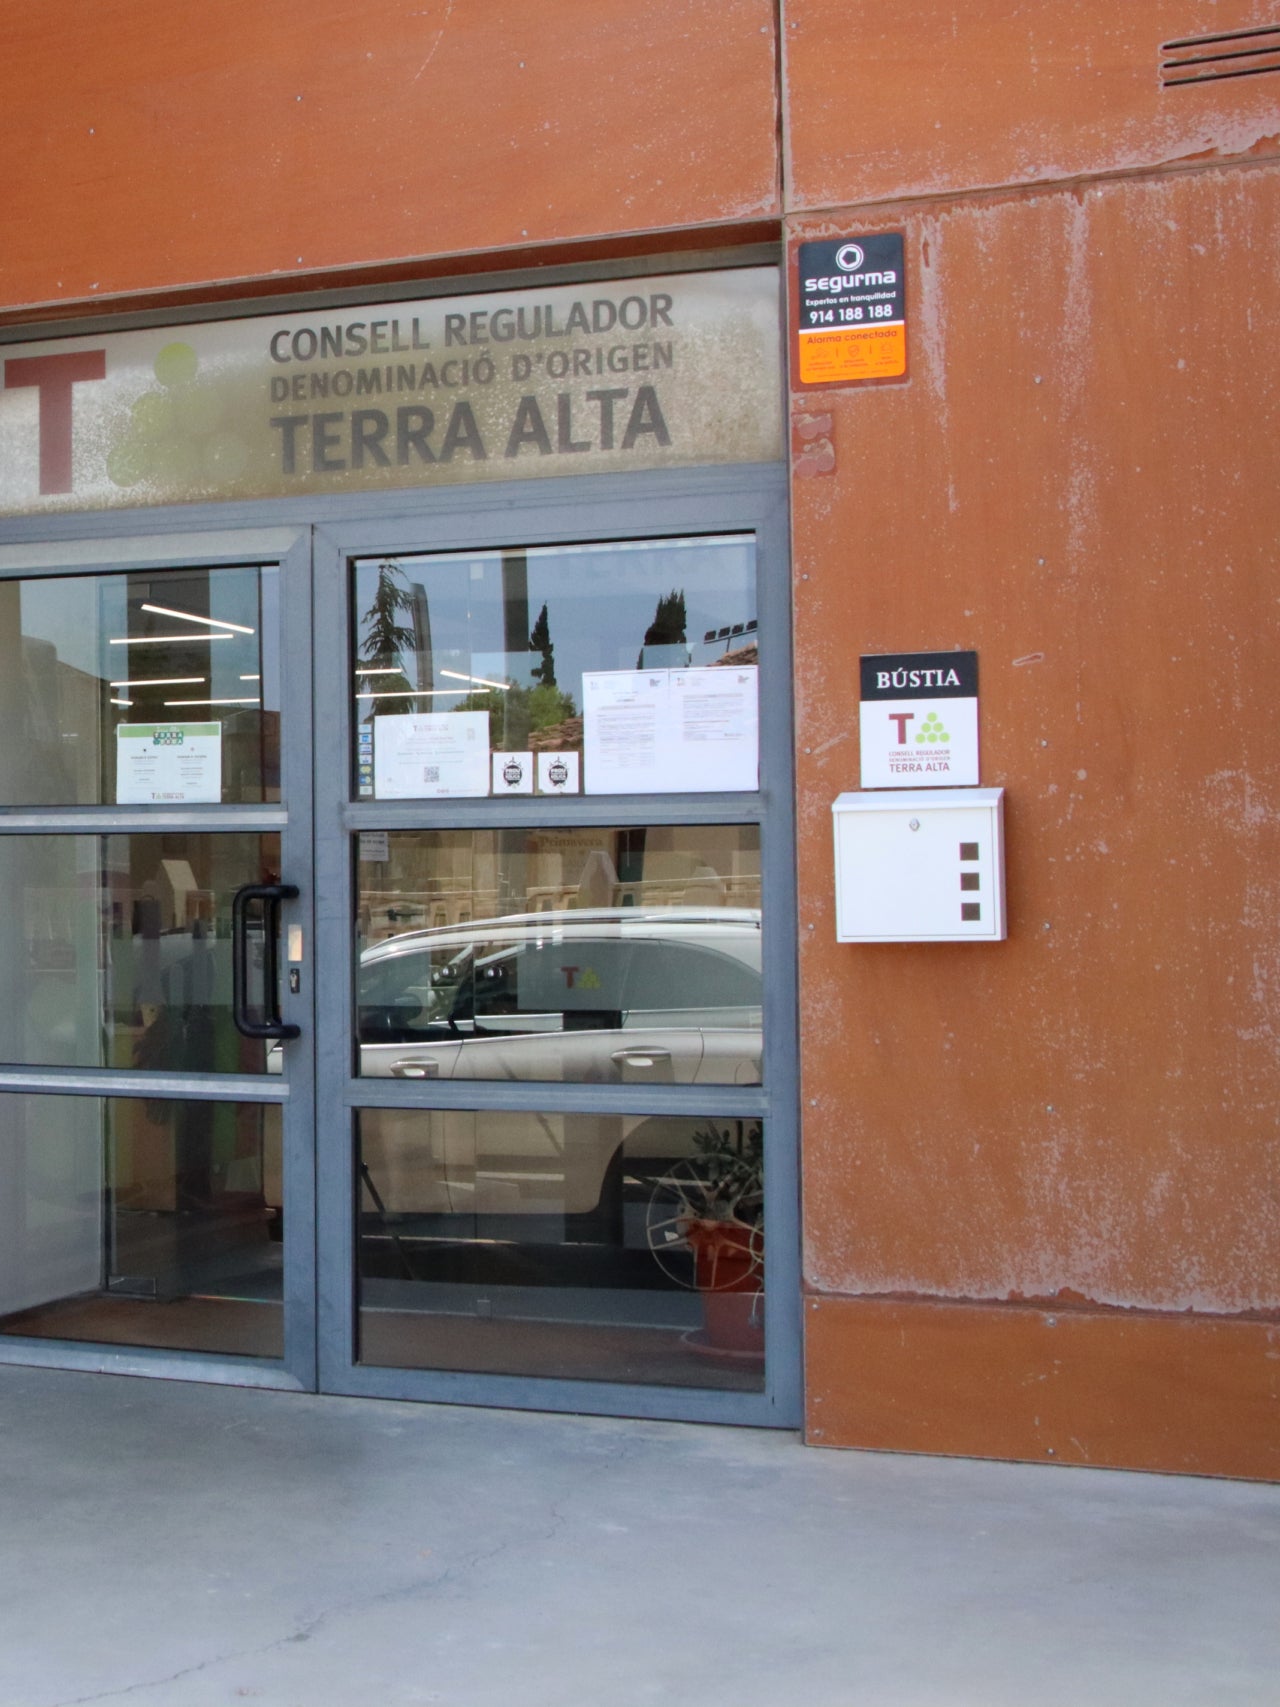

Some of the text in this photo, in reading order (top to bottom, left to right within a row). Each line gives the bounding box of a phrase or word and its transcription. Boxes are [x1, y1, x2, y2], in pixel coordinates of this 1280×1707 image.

[804, 270, 897, 294] segurma
[805, 297, 838, 307] Expertos
[850, 291, 897, 302] tranquilidad
[809, 303, 893, 324] 914 188 188
[270, 293, 675, 363] CONSELL REGULADOR
[807, 330, 897, 344] Alarma conectada
[271, 340, 674, 402] DENOMINACIÓ D'ORIGEN
[5, 348, 106, 495] T
[270, 384, 673, 475] TERRA ALTA
[876, 667, 961, 689] BÚSTIA
[888, 712, 915, 745] T
[889, 762, 950, 773] TERRA ALTA
